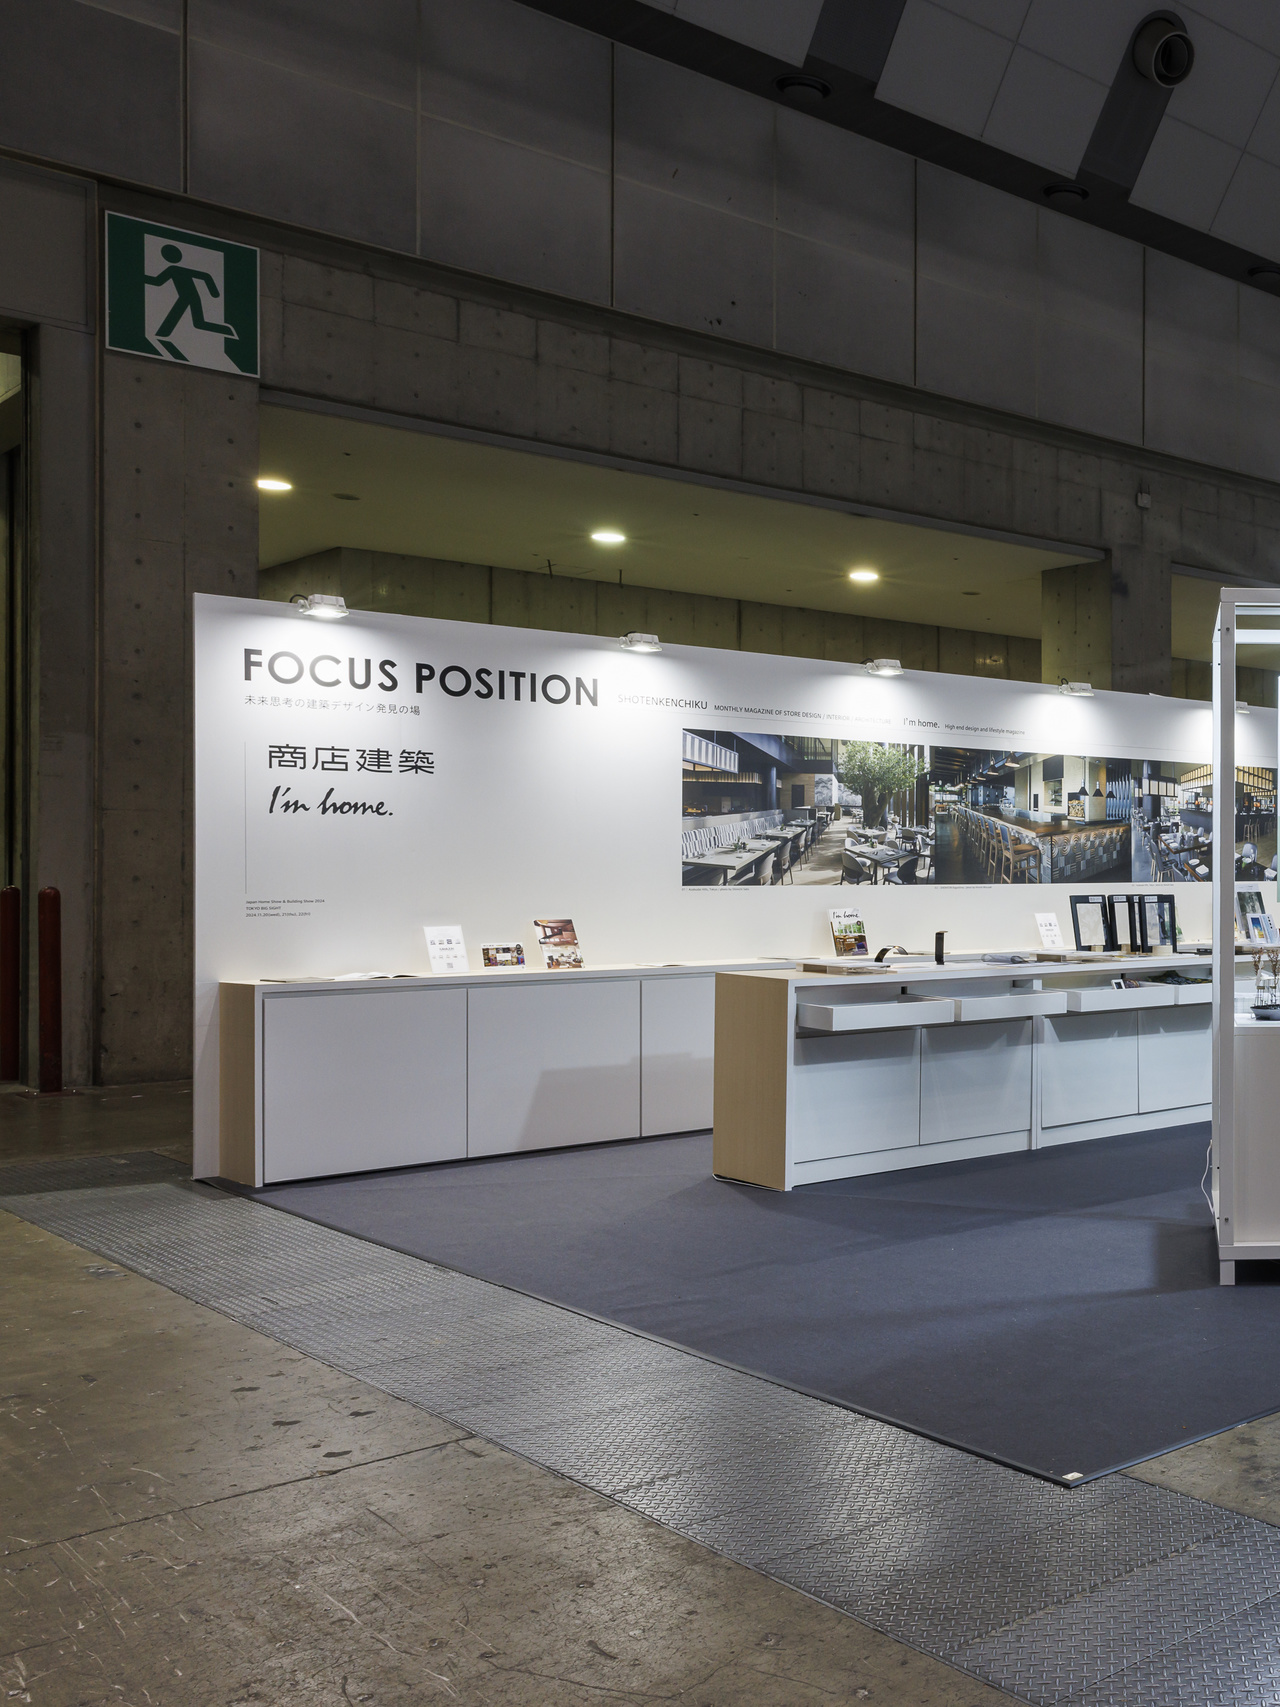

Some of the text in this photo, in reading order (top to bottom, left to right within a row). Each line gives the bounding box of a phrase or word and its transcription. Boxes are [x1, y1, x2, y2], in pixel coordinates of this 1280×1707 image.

[243, 647, 599, 707] FOCUS POSITION
[244, 694, 421, 717] 未来思考の建築デザイン発見の場
[617, 693, 709, 711] SHOTENKENCHIKU
[713, 704, 743, 714] MONTHLY
[744, 706, 774, 717] MAGAZINE
[784, 710, 801, 718] STORE
[802, 711, 822, 719] DESIGN
[826, 714, 850, 722] INTERIOR
[917, 718, 941, 729] home.
[944, 723, 956, 731] High
[965, 725, 980, 733] design
[267, 743, 436, 775] 商店建築
[268, 785, 394, 817] I'm home.
